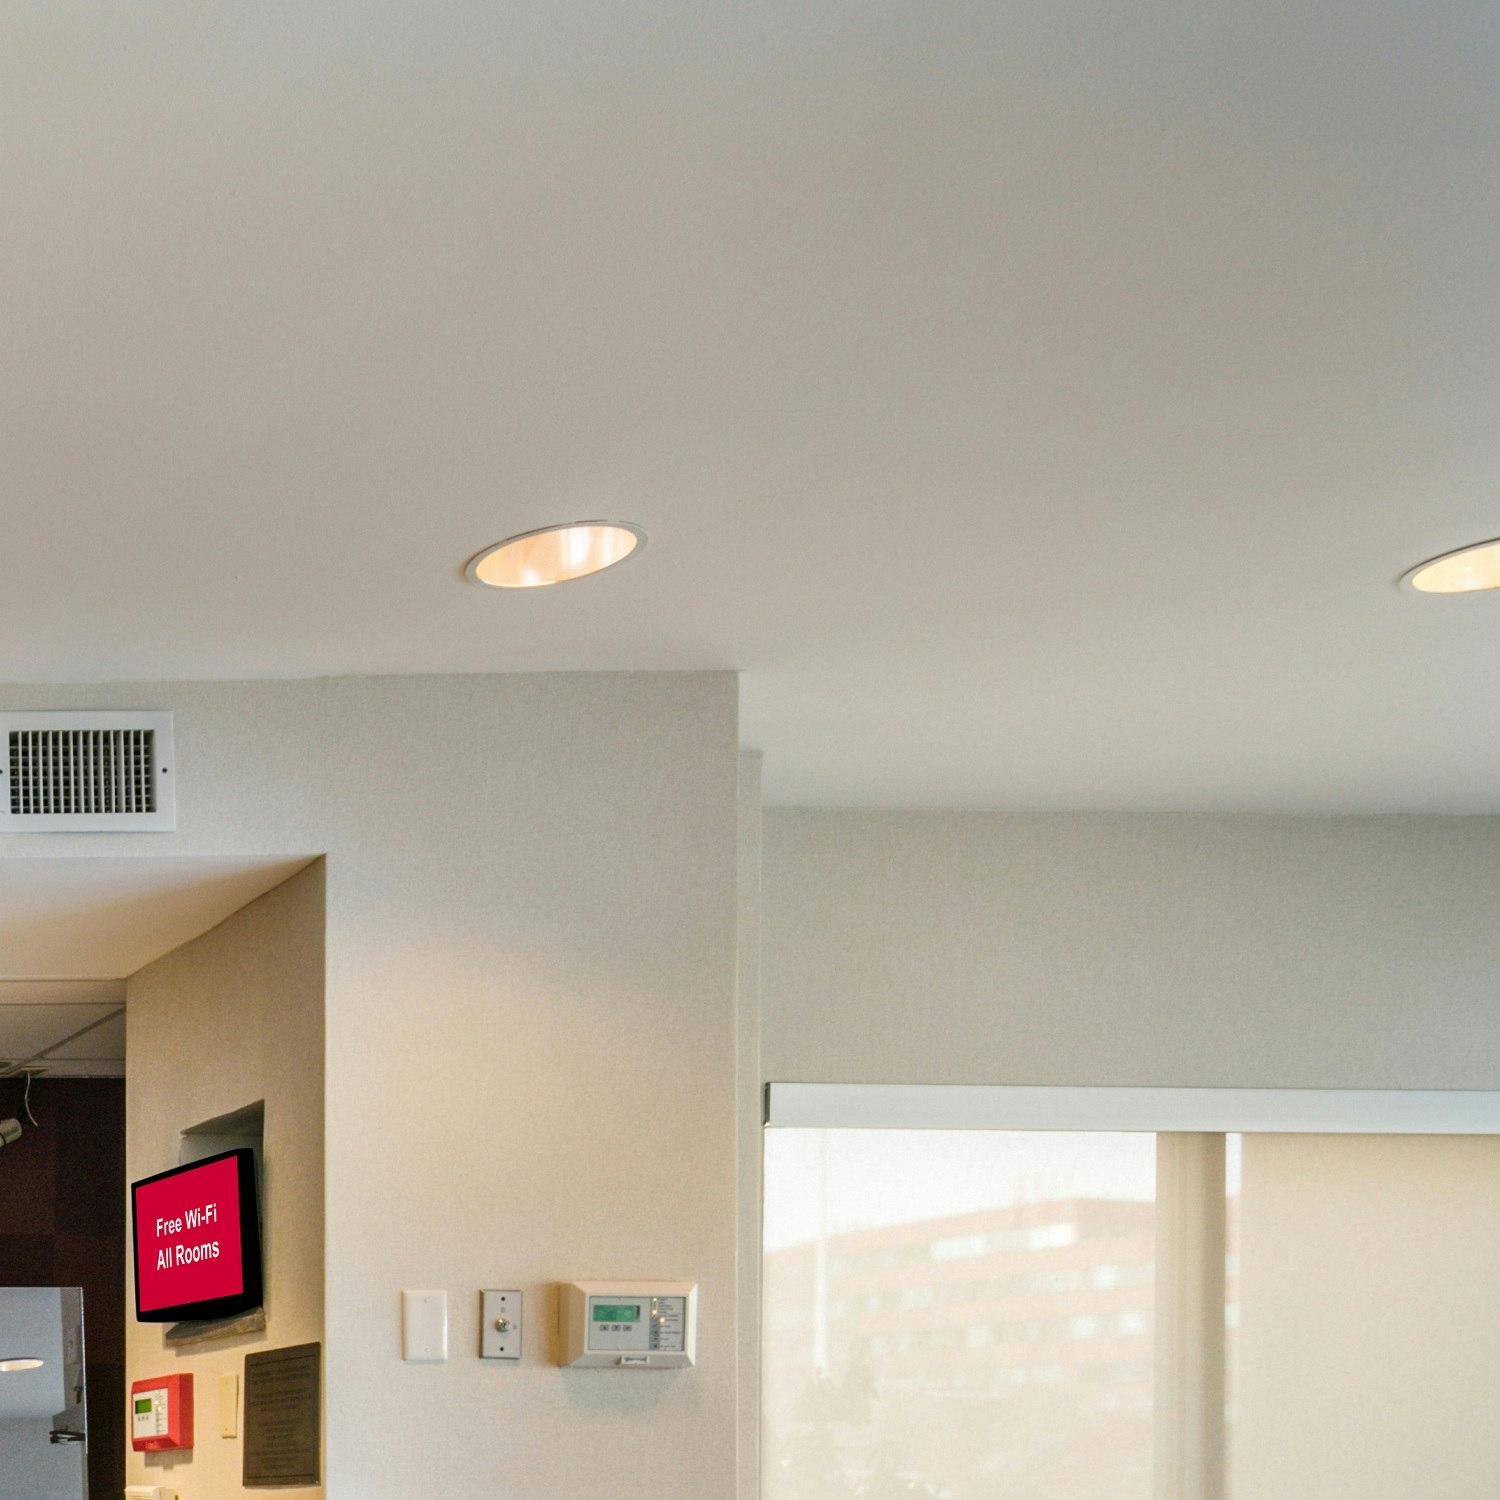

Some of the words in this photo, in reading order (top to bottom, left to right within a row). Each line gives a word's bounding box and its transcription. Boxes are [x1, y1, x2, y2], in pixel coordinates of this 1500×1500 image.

[156, 1216, 182, 1237] Free
[184, 1202, 217, 1229] Wi-Fi
[156, 1247, 173, 1271] All
[175, 1240, 220, 1267] Rooms
